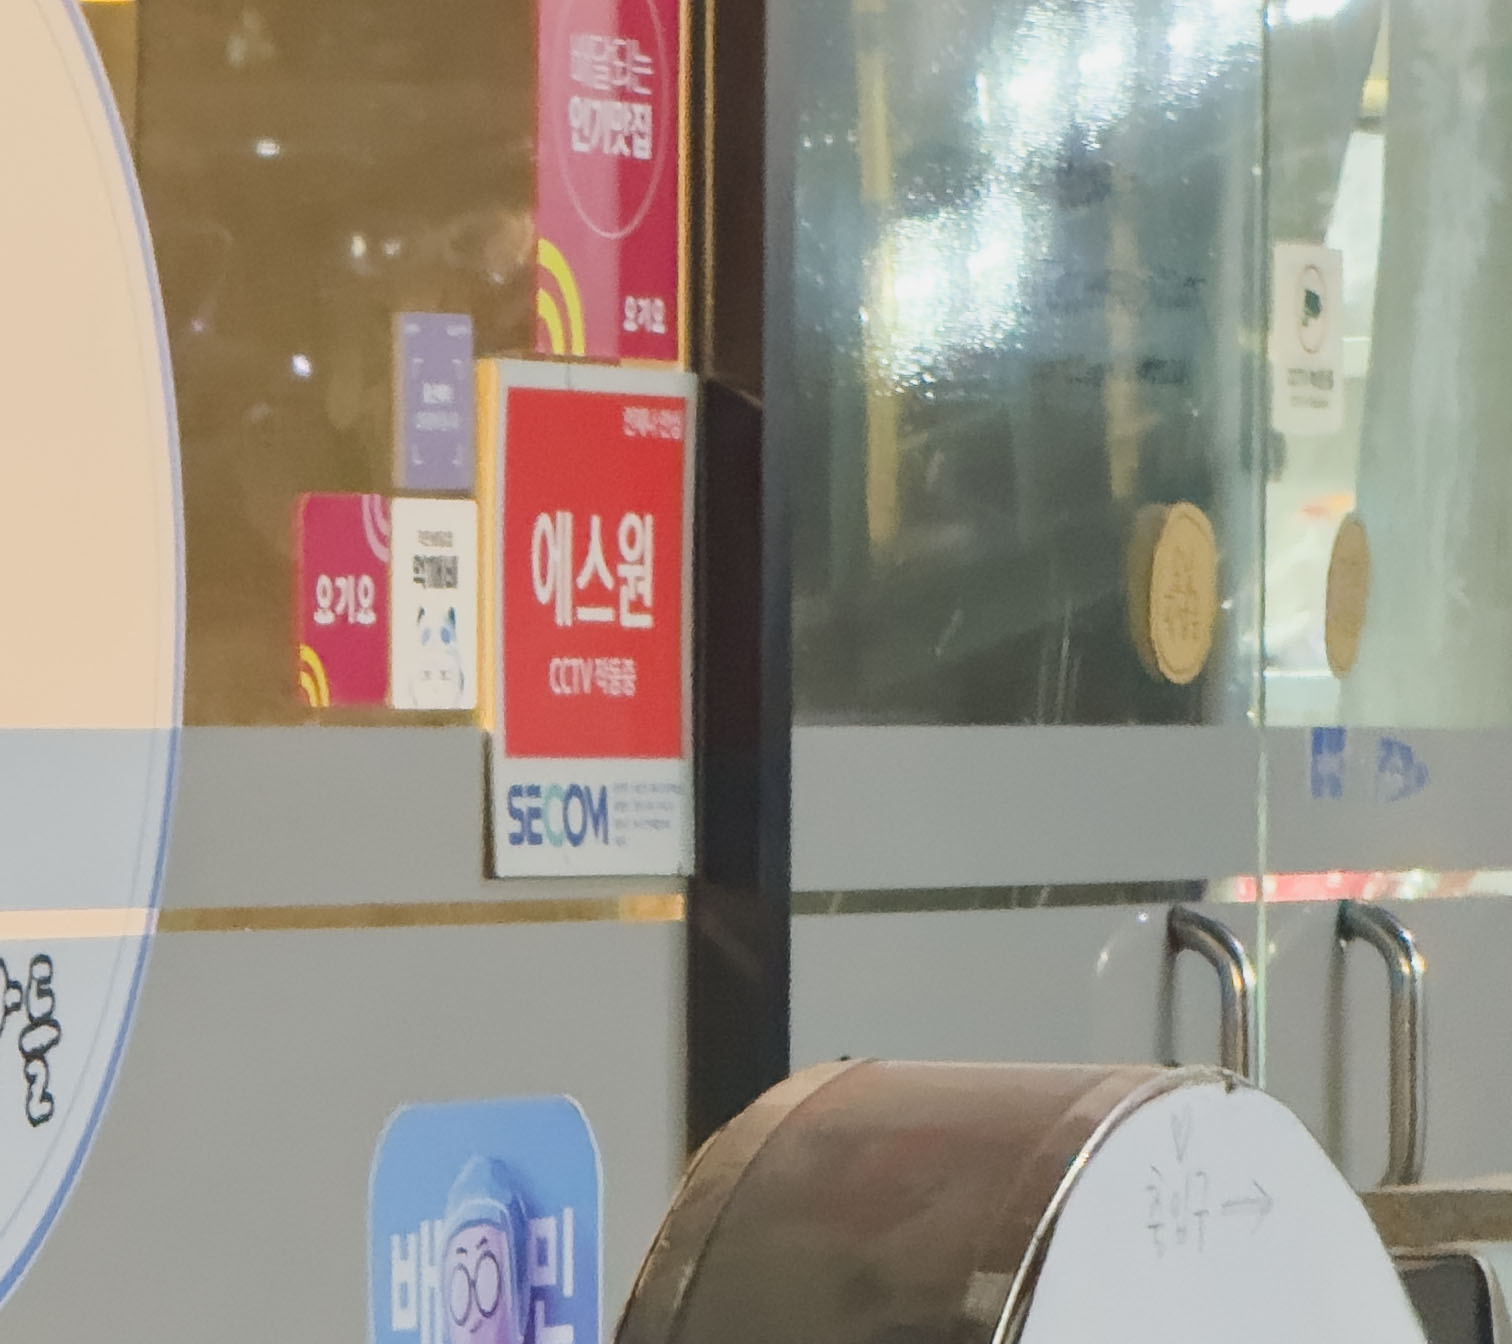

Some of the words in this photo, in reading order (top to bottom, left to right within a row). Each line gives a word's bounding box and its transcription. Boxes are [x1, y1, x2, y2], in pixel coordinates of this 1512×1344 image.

[531, 511, 656, 629] 에스원
[313, 573, 376, 626] 요기요
[548, 656, 592, 696] CCTV
[507, 783, 609, 847] SECOM
